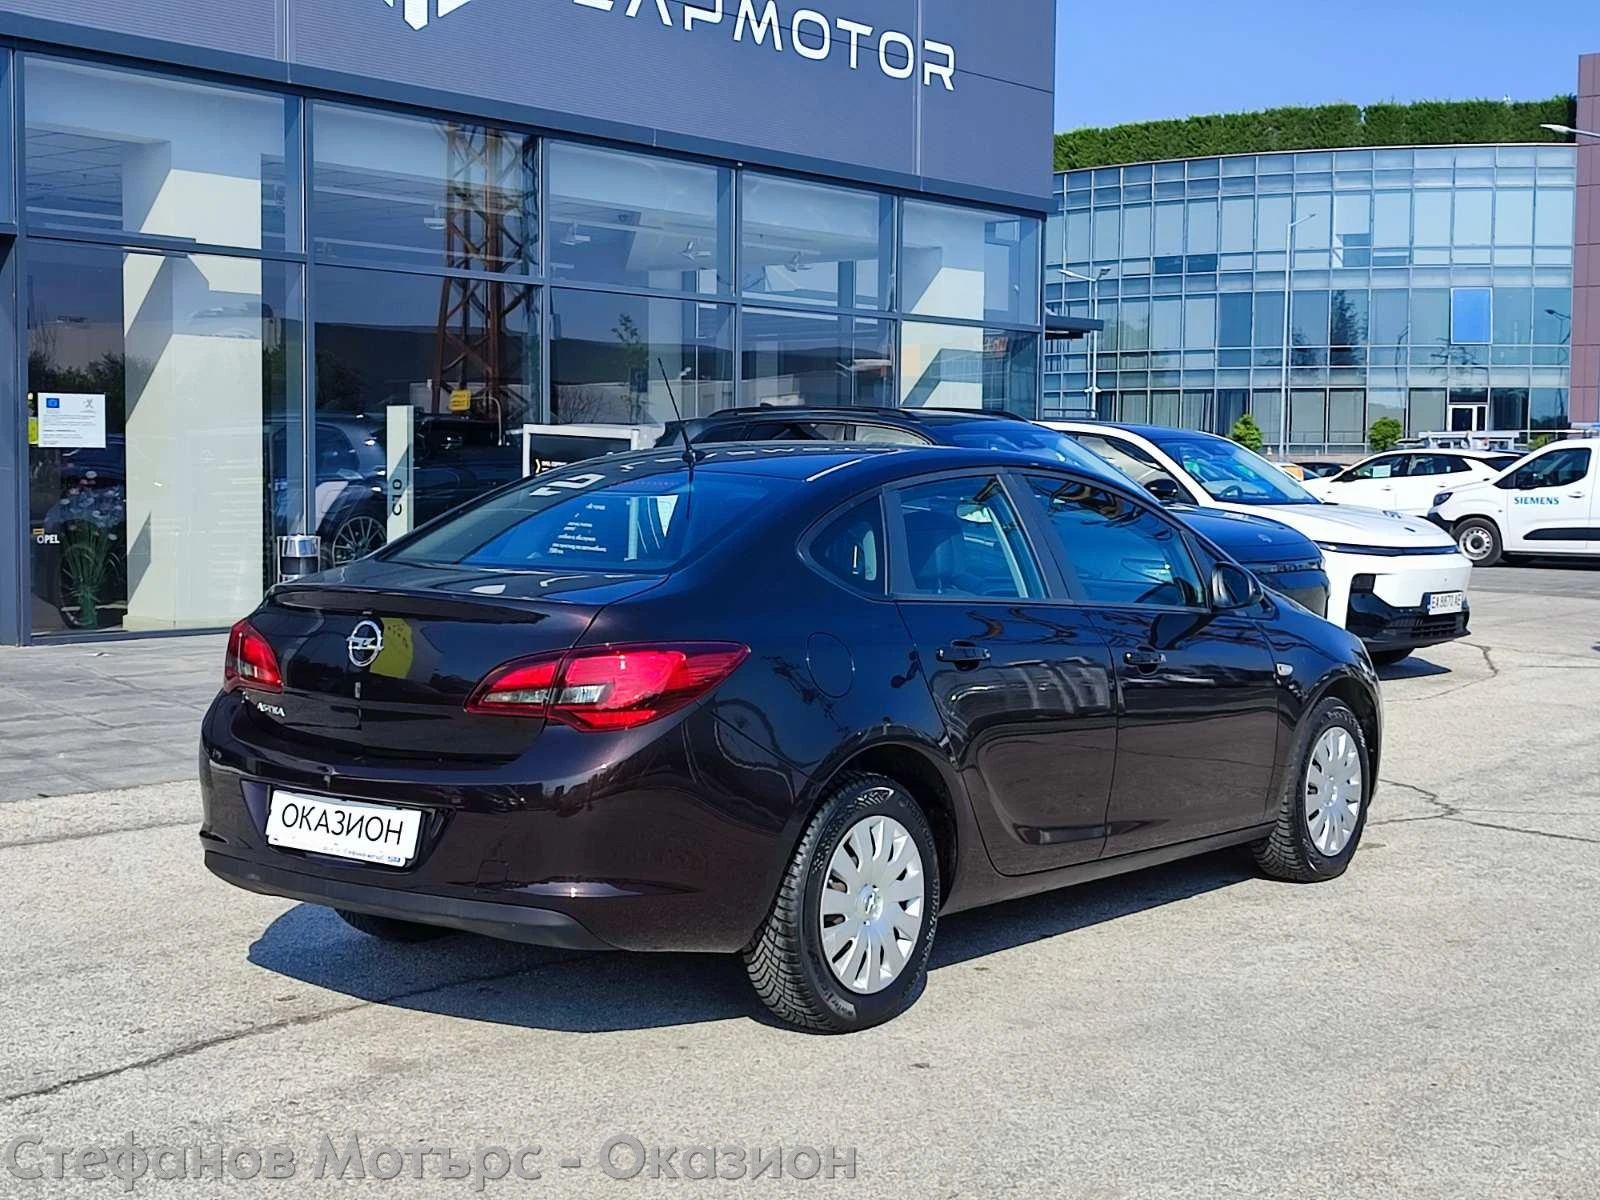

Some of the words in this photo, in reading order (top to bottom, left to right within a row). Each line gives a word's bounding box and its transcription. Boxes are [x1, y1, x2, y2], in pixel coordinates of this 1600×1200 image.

[1513, 496, 1560, 505] SIEMENS
[36, 534, 61, 545] OPEL
[281, 802, 404, 846] ОКАЗИОН
